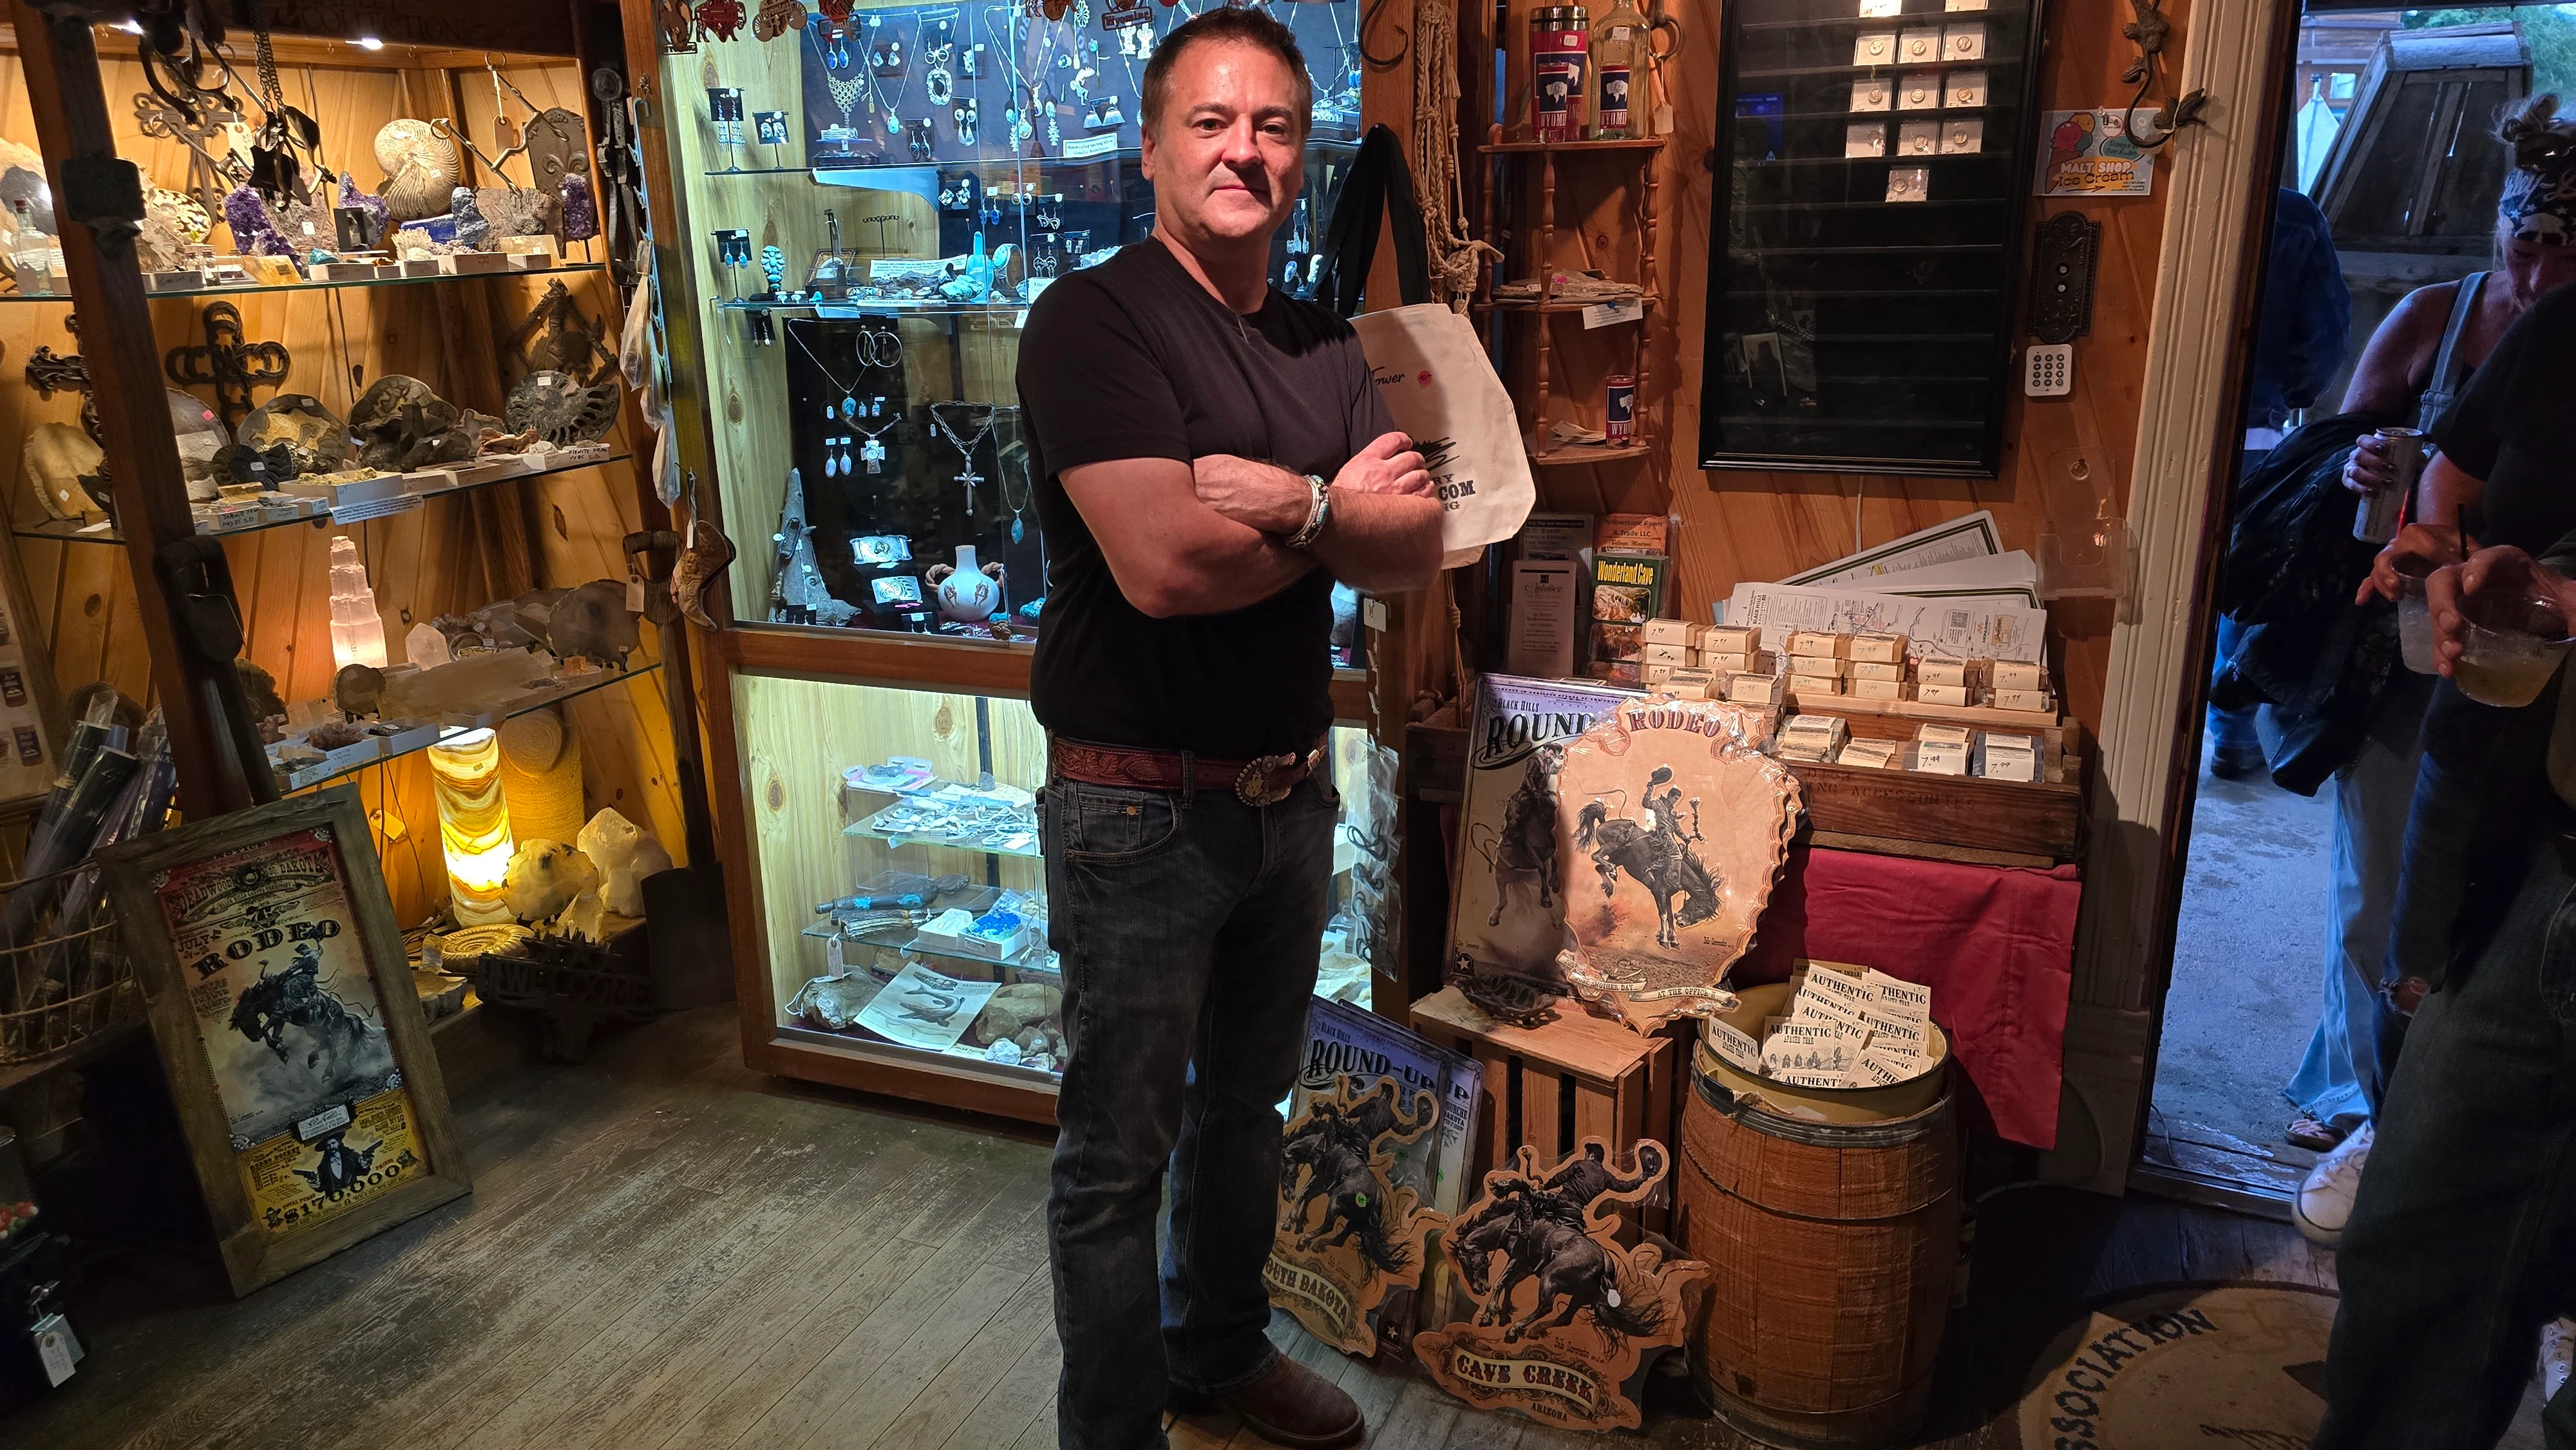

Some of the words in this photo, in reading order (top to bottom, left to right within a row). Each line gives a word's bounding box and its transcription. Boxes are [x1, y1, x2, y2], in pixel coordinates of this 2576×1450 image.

[2061, 162, 2094, 174] MALT
[2098, 162, 2132, 174] SHOP
[2059, 176, 2081, 187] Ice
[2084, 171, 2134, 184] Cream
[1604, 518, 1642, 526] Yellowstone
[1597, 560, 1638, 584] Wonderland
[1638, 563, 1654, 585] Cave
[1499, 698, 1519, 710] BLACK
[1520, 700, 1540, 713] HILLS
[1626, 709, 1721, 739] RODEO
[1921, 755, 1940, 767] 7.99
[1991, 762, 2011, 773] 7.99
[181, 876, 233, 914] DEADWOOD
[279, 852, 324, 874] DAKOTA
[178, 934, 209, 952] JULY
[194, 919, 341, 981] RODEO
[1591, 981, 1619, 991] ANOTHER
[1685, 988, 1709, 997] OFFICE
[1810, 974, 1875, 1003] AUTHENTIC
[1881, 984, 1927, 1005] THENTIC
[1320, 1021, 1336, 1038] BLACK
[1337, 1028, 1351, 1044] HILLS
[1768, 1024, 1832, 1038] AUTHENTIC
[1783, 1035, 1801, 1044] APACHE
[1803, 1036, 1815, 1045] TEAR
[1712, 1025, 1756, 1058] AUTHENTIC
[1722, 1041, 1735, 1055] APACHE
[1307, 1039, 1436, 1089] ROUND-UP
[1861, 1057, 1899, 1085] AUTHE
[1265, 1256, 1298, 1288] OUTH
[1299, 1274, 1347, 1325] DAKOTA
[1456, 1354, 1511, 1384] CAVE
[1522, 1364, 1595, 1405] CREEK
[1530, 1402, 1568, 1422] ARIZONA
